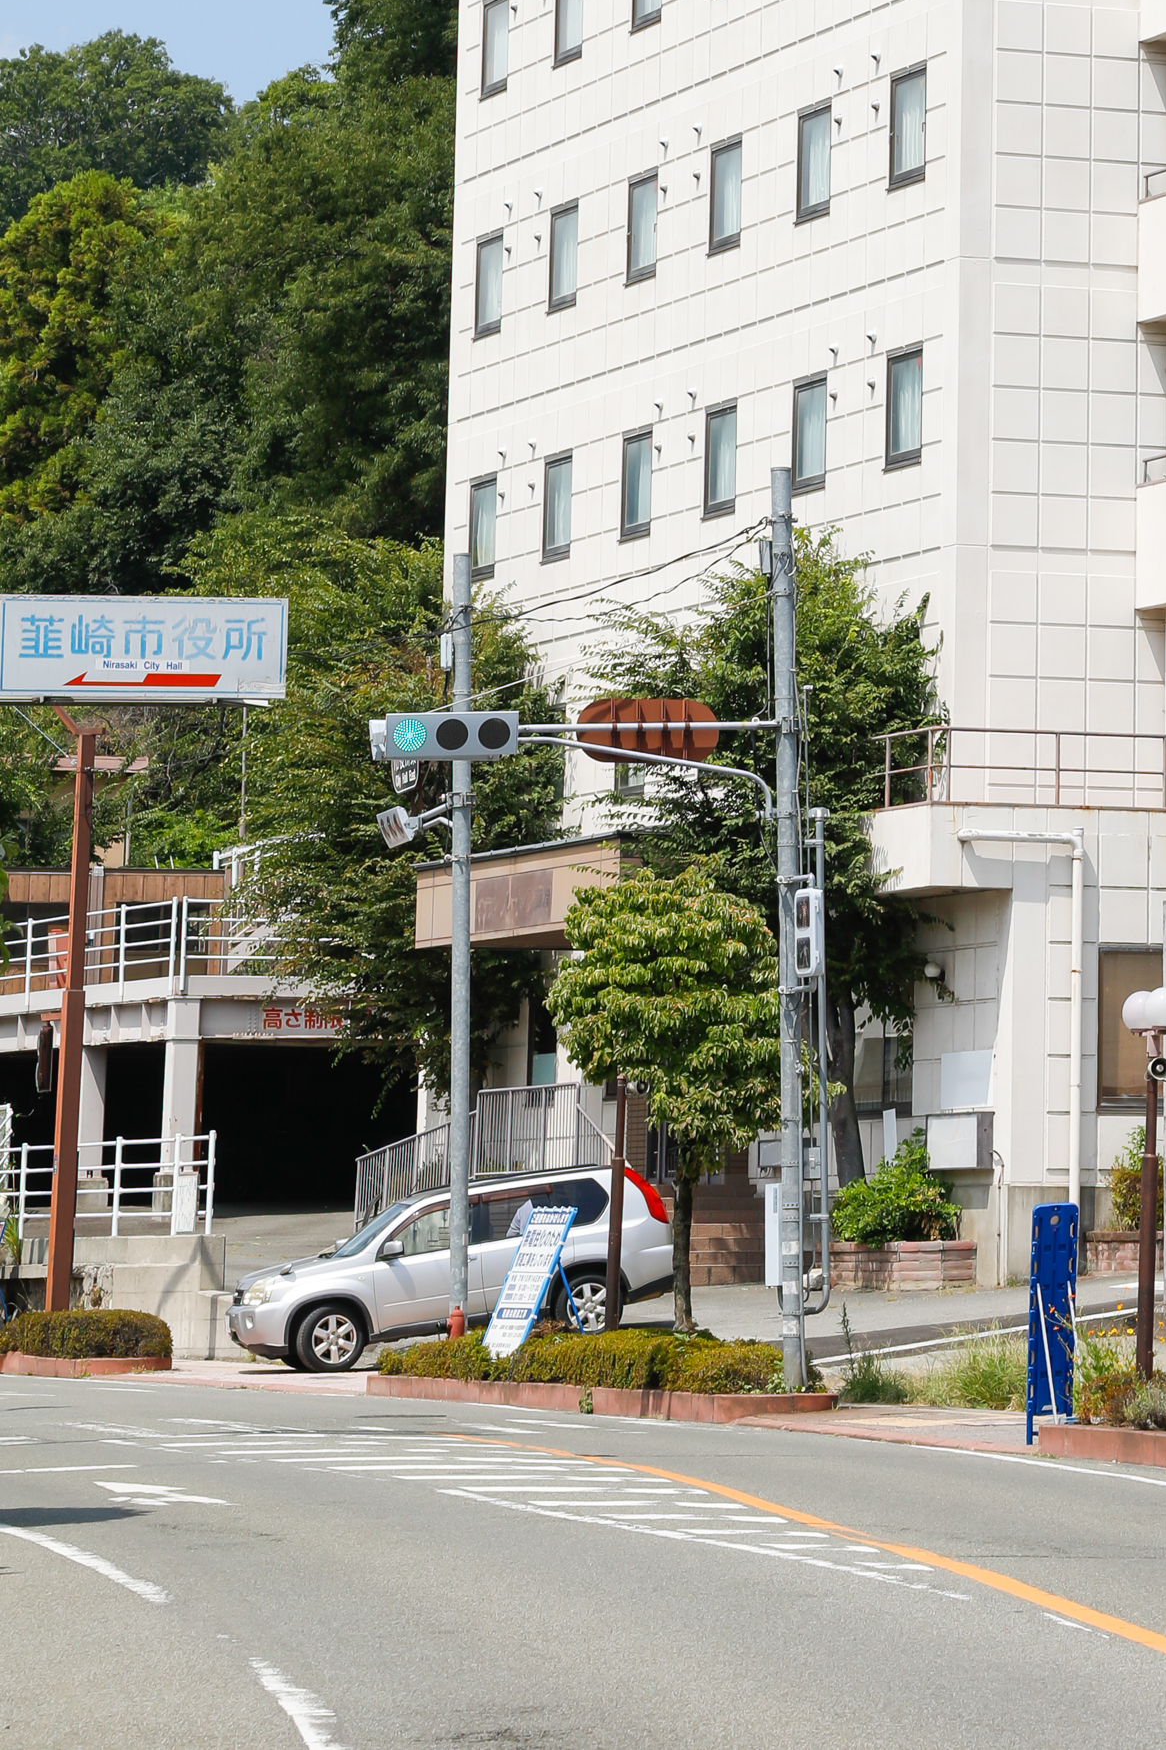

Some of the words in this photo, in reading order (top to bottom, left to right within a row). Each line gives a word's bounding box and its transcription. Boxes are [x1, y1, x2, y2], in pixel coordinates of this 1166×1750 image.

[19, 614, 267, 661] 韮崎市役所
[102, 660, 138, 670] Nirasaki
[143, 661, 160, 671] City
[166, 661, 183, 671] Hall
